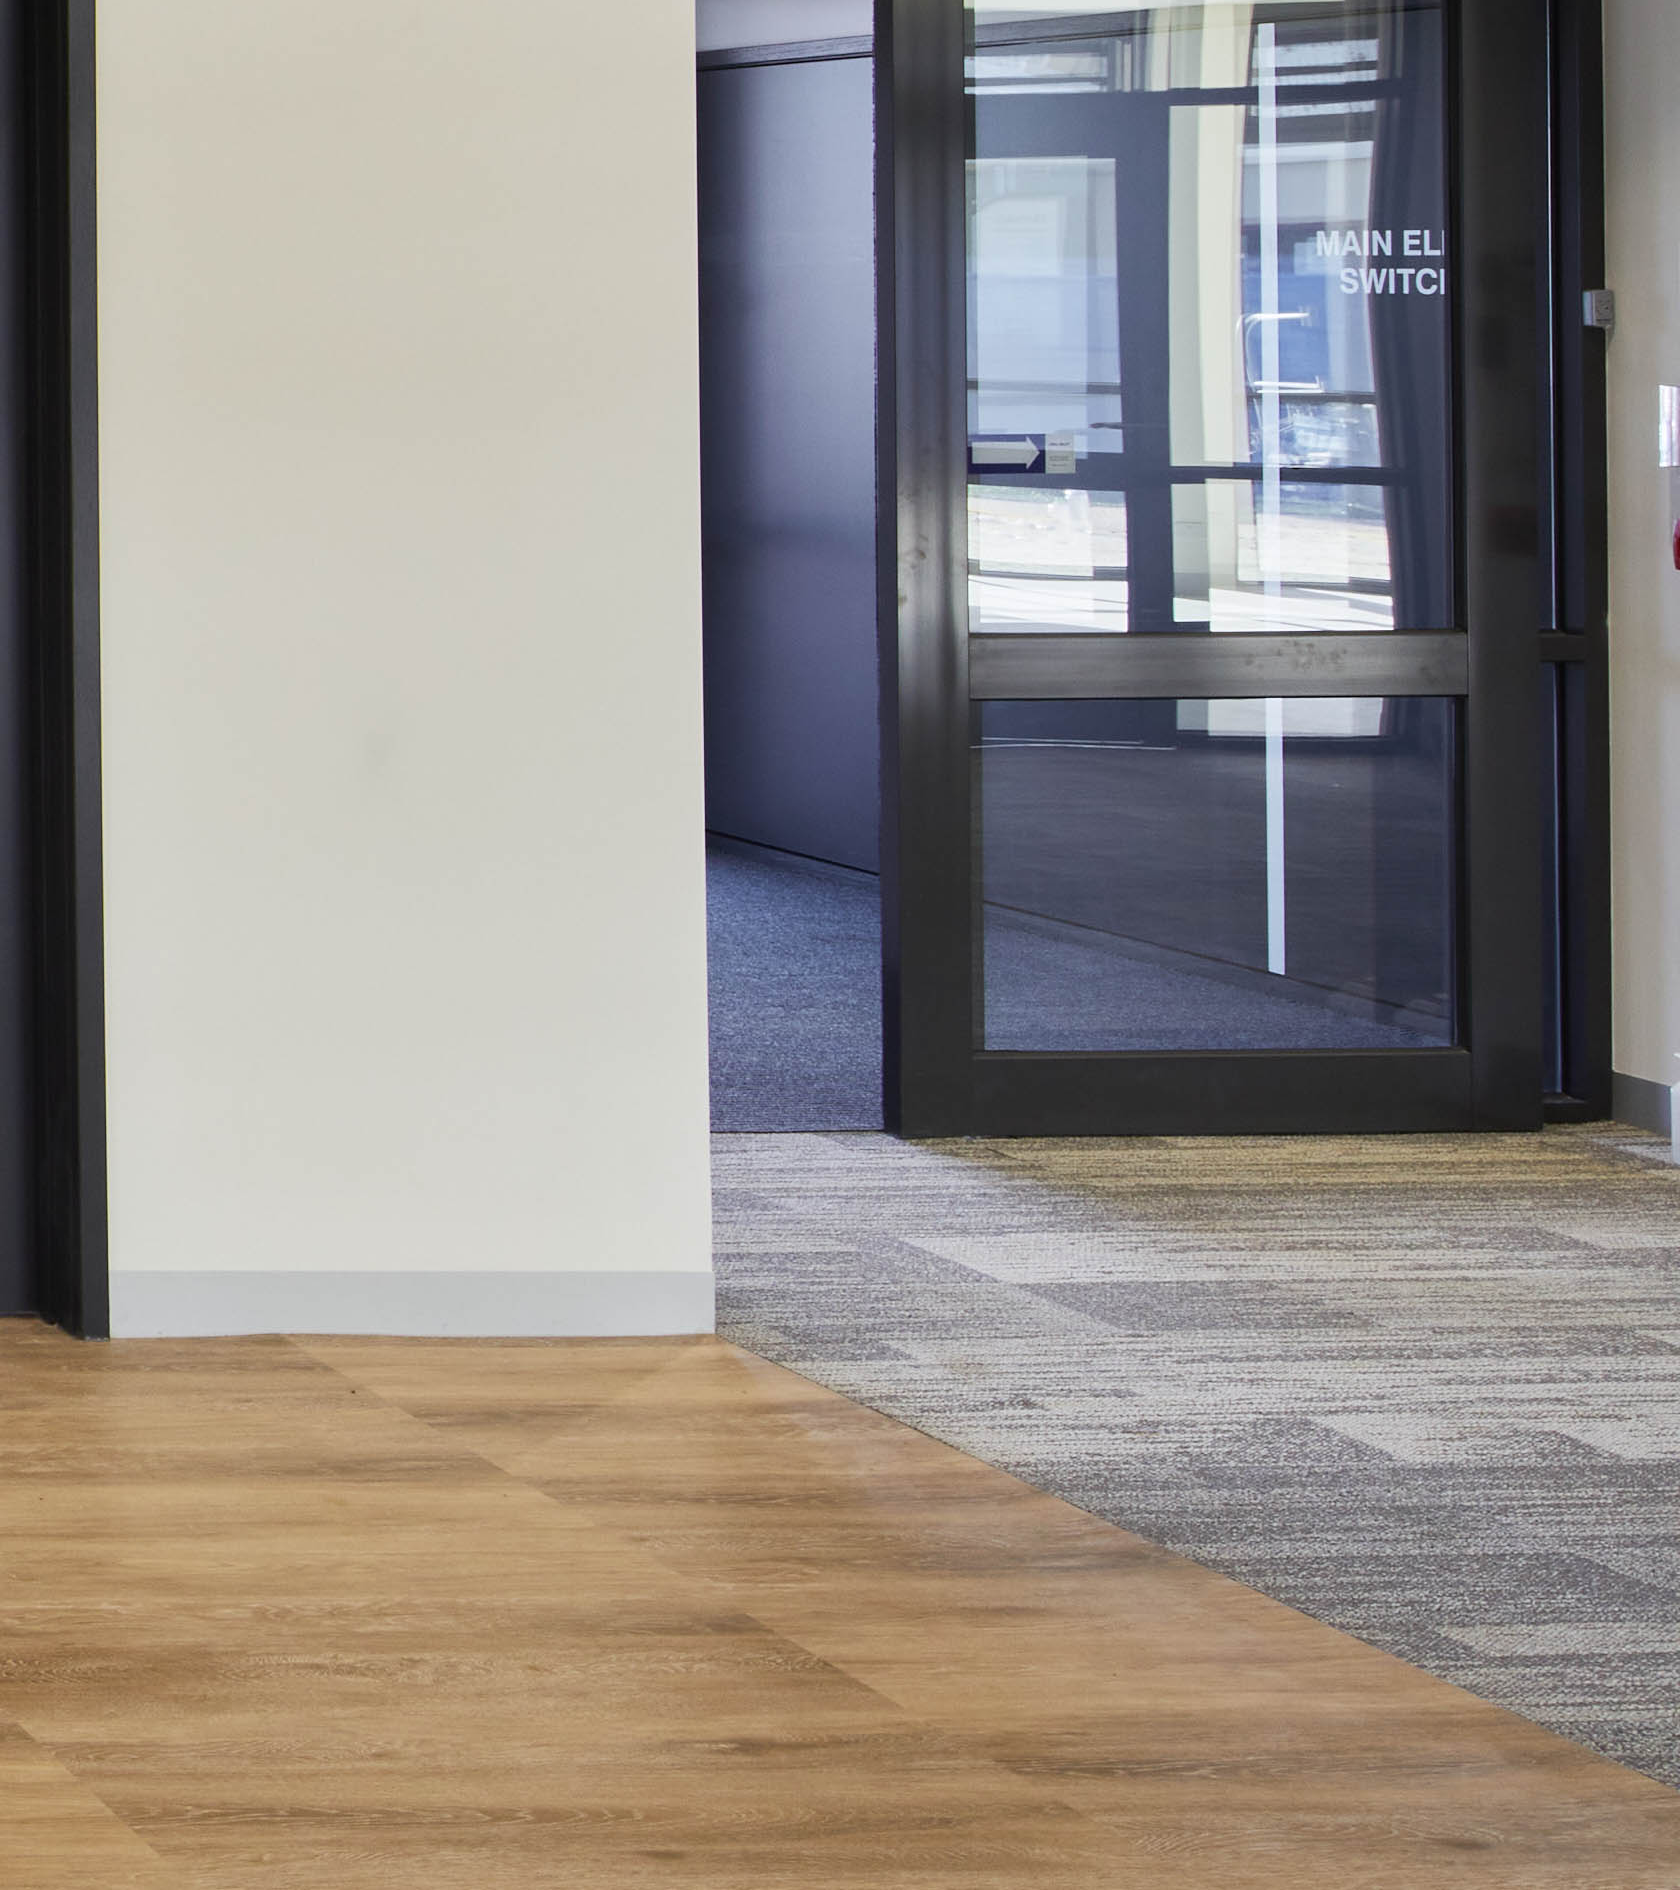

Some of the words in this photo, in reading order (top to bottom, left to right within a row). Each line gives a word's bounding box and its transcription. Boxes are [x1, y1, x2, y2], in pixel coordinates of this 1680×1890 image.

[1316, 230, 1392, 256] MAIN
[1403, 230, 1445, 256] EL
[1339, 267, 1445, 295] SWITC
